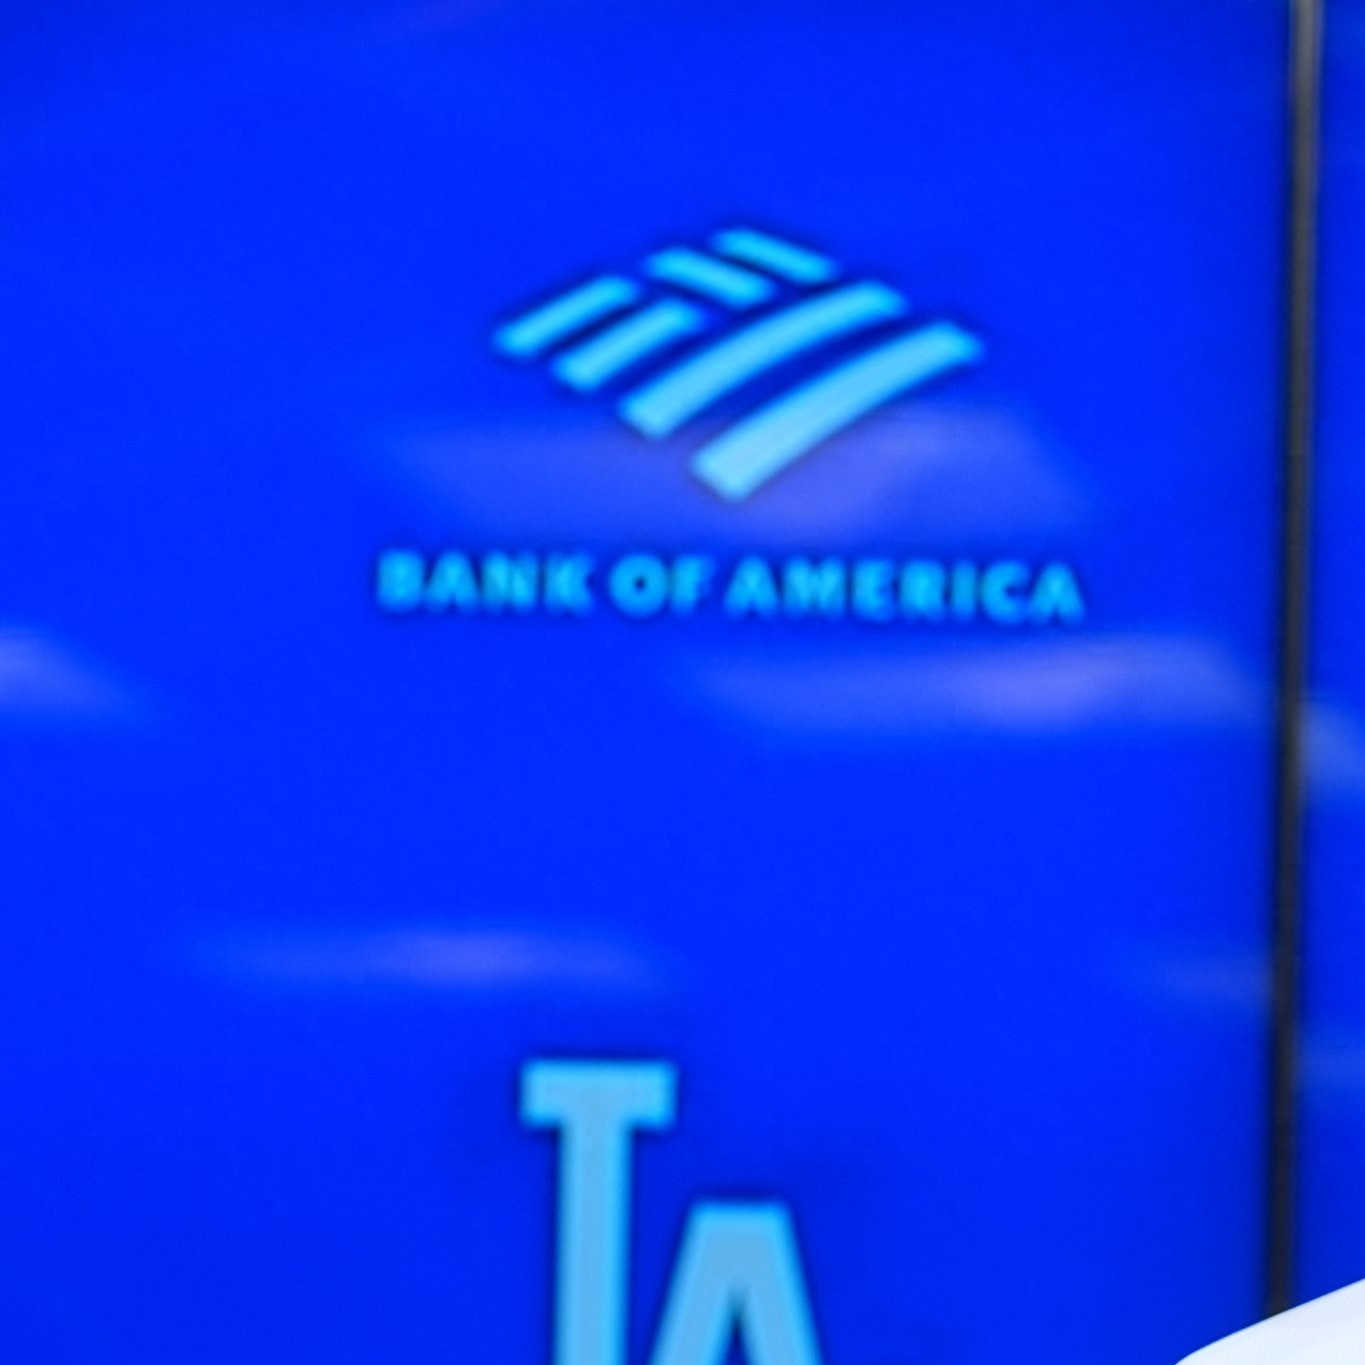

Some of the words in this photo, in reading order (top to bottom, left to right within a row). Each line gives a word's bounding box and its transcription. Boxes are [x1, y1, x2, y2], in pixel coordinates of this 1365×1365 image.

[376, 549, 594, 615] BANK
[608, 553, 712, 617] OF
[725, 556, 1083, 623] AMERICA
